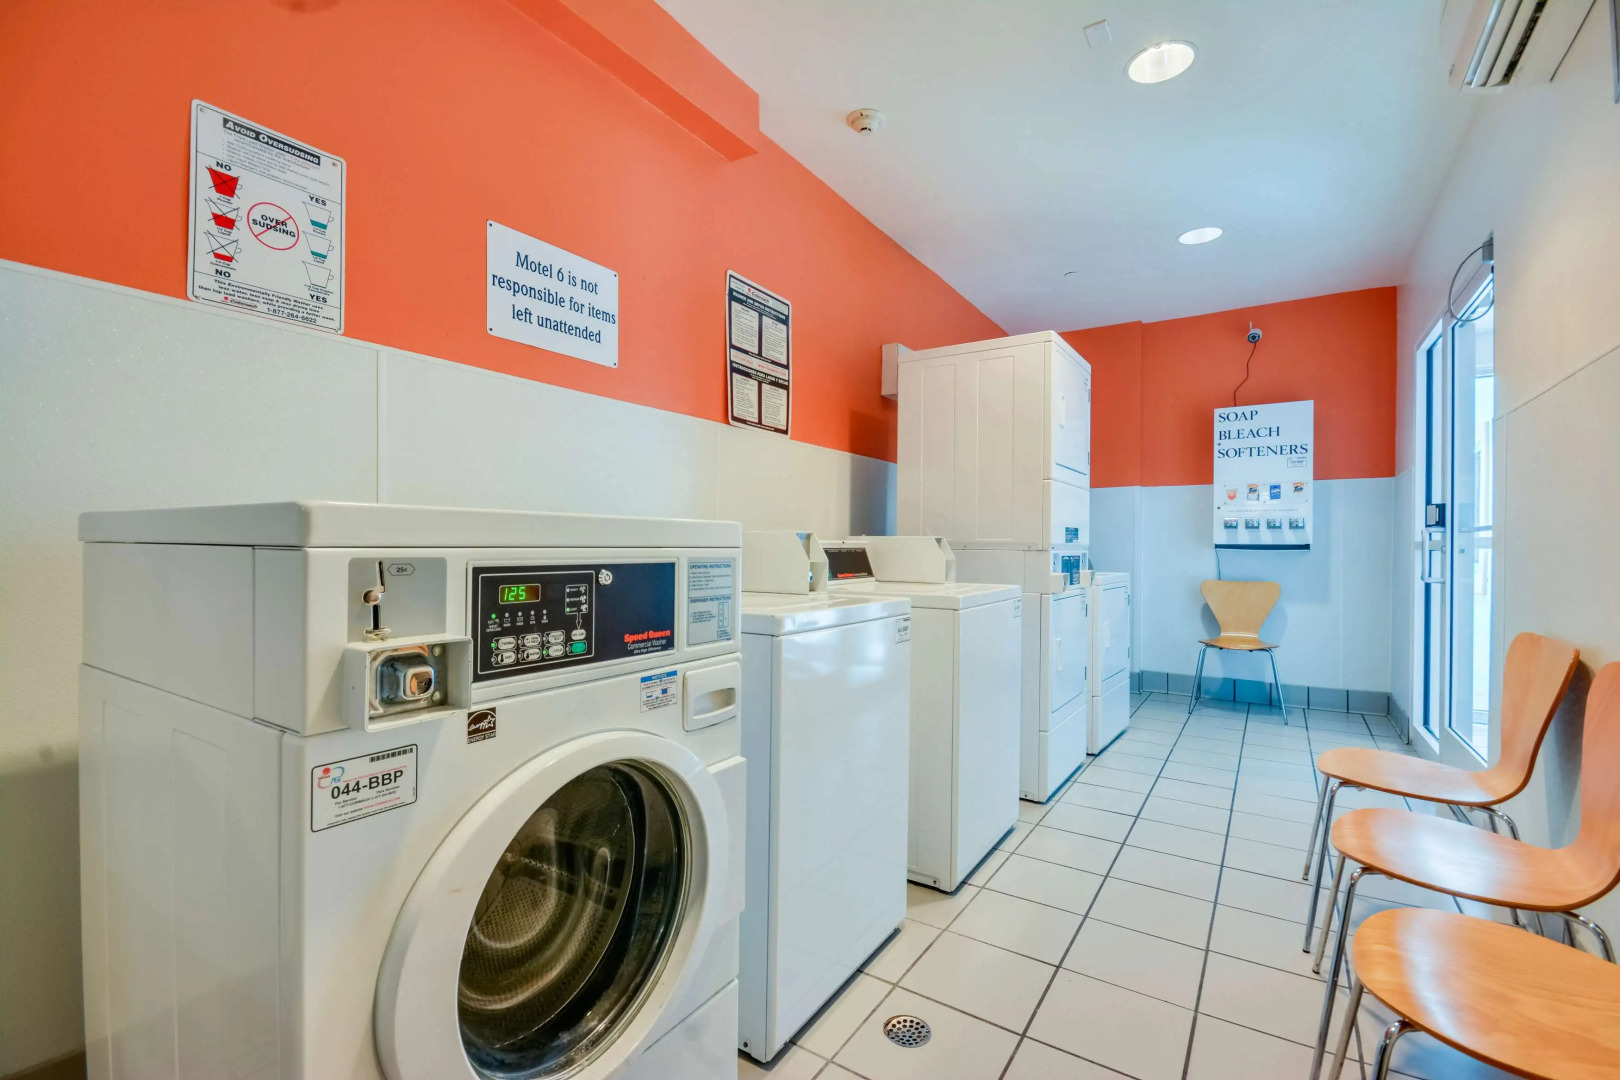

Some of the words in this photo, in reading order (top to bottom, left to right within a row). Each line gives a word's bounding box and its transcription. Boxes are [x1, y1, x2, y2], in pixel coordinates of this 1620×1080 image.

[225, 121, 256, 138] AVOID
[259, 134, 319, 164] OVERSUDSING
[216, 160, 231, 172] NO
[309, 194, 326, 206] YES
[251, 217, 295, 238] SUDSING
[260, 213, 287, 228] OVER
[215, 268, 230, 278] NO
[515, 251, 553, 278] Motel
[557, 268, 564, 282] 6
[568, 271, 577, 287] is
[580, 279, 598, 295] not
[198, 284, 211, 292] than
[277, 304, 300, 314] providing
[227, 282, 270, 297] Environmentally
[271, 293, 291, 302] Friendly
[293, 299, 310, 307] Washer
[309, 292, 327, 303] YES
[491, 274, 565, 308] responsible
[569, 296, 585, 314] for
[588, 303, 616, 324] items
[292, 303, 307, 311] drying
[512, 304, 533, 324] left
[537, 315, 601, 343] unattended
[1218, 410, 1258, 423] SOAP
[1218, 426, 1280, 440] BLEACH
[1217, 443, 1308, 458] SOFTENERS
[504, 586, 526, 601] 125
[624, 631, 648, 643] Speed
[649, 630, 671, 639] Queen
[628, 641, 651, 650] Commercial
[331, 769, 404, 799] 044-BBP
